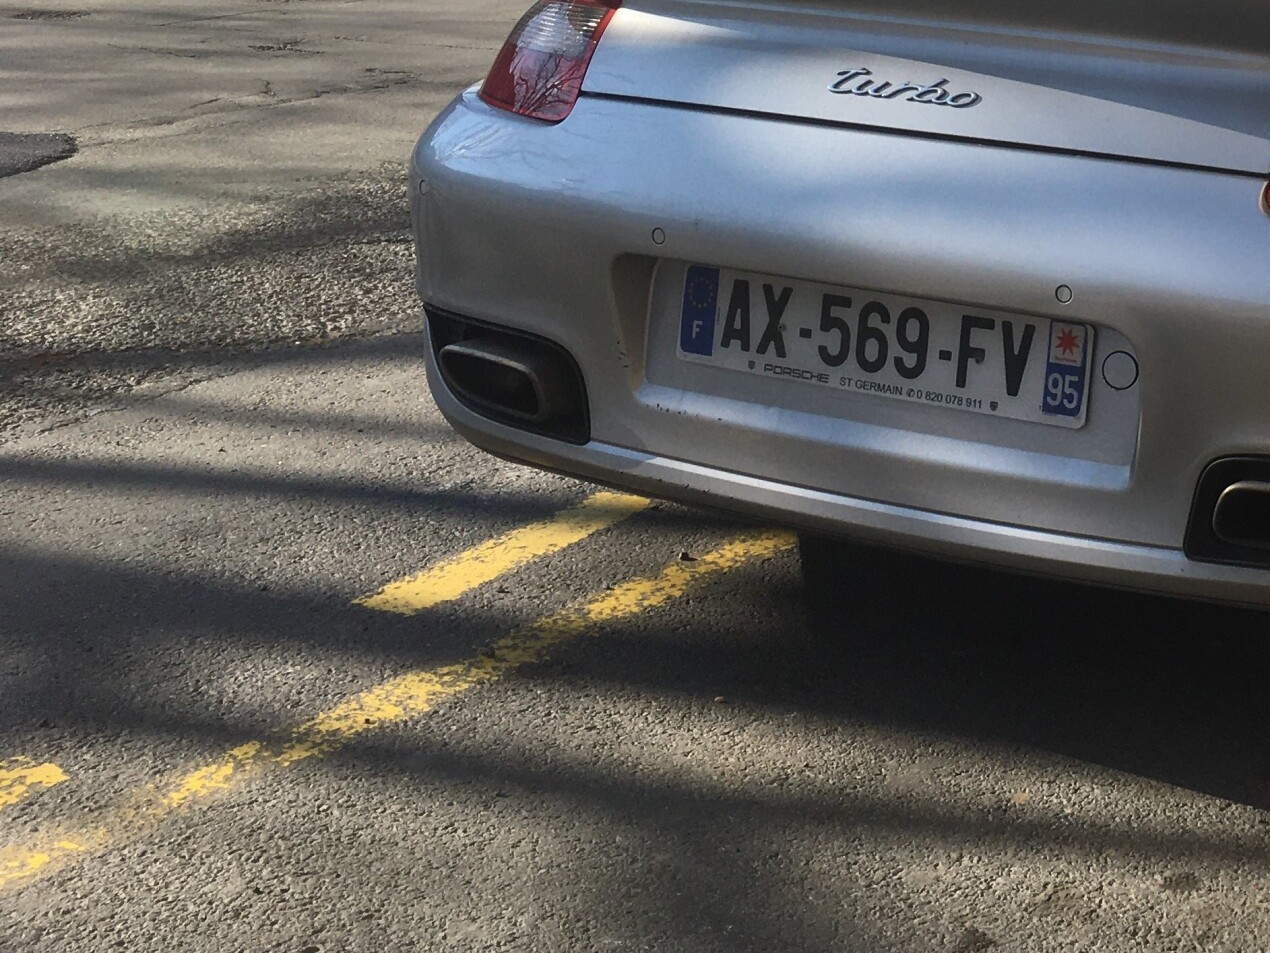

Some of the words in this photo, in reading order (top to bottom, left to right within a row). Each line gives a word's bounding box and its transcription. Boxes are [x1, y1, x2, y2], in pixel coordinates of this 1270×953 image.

[691, 320, 703, 339] F
[720, 279, 1036, 398] AX-569-FV
[763, 363, 830, 384] PORSCHE
[839, 376, 853, 388] ST
[855, 379, 903, 396] GERMAIN
[925, 391, 943, 403] 820
[945, 394, 963, 406] 078
[965, 398, 982, 409] 911
[1046, 372, 1080, 409] 95
